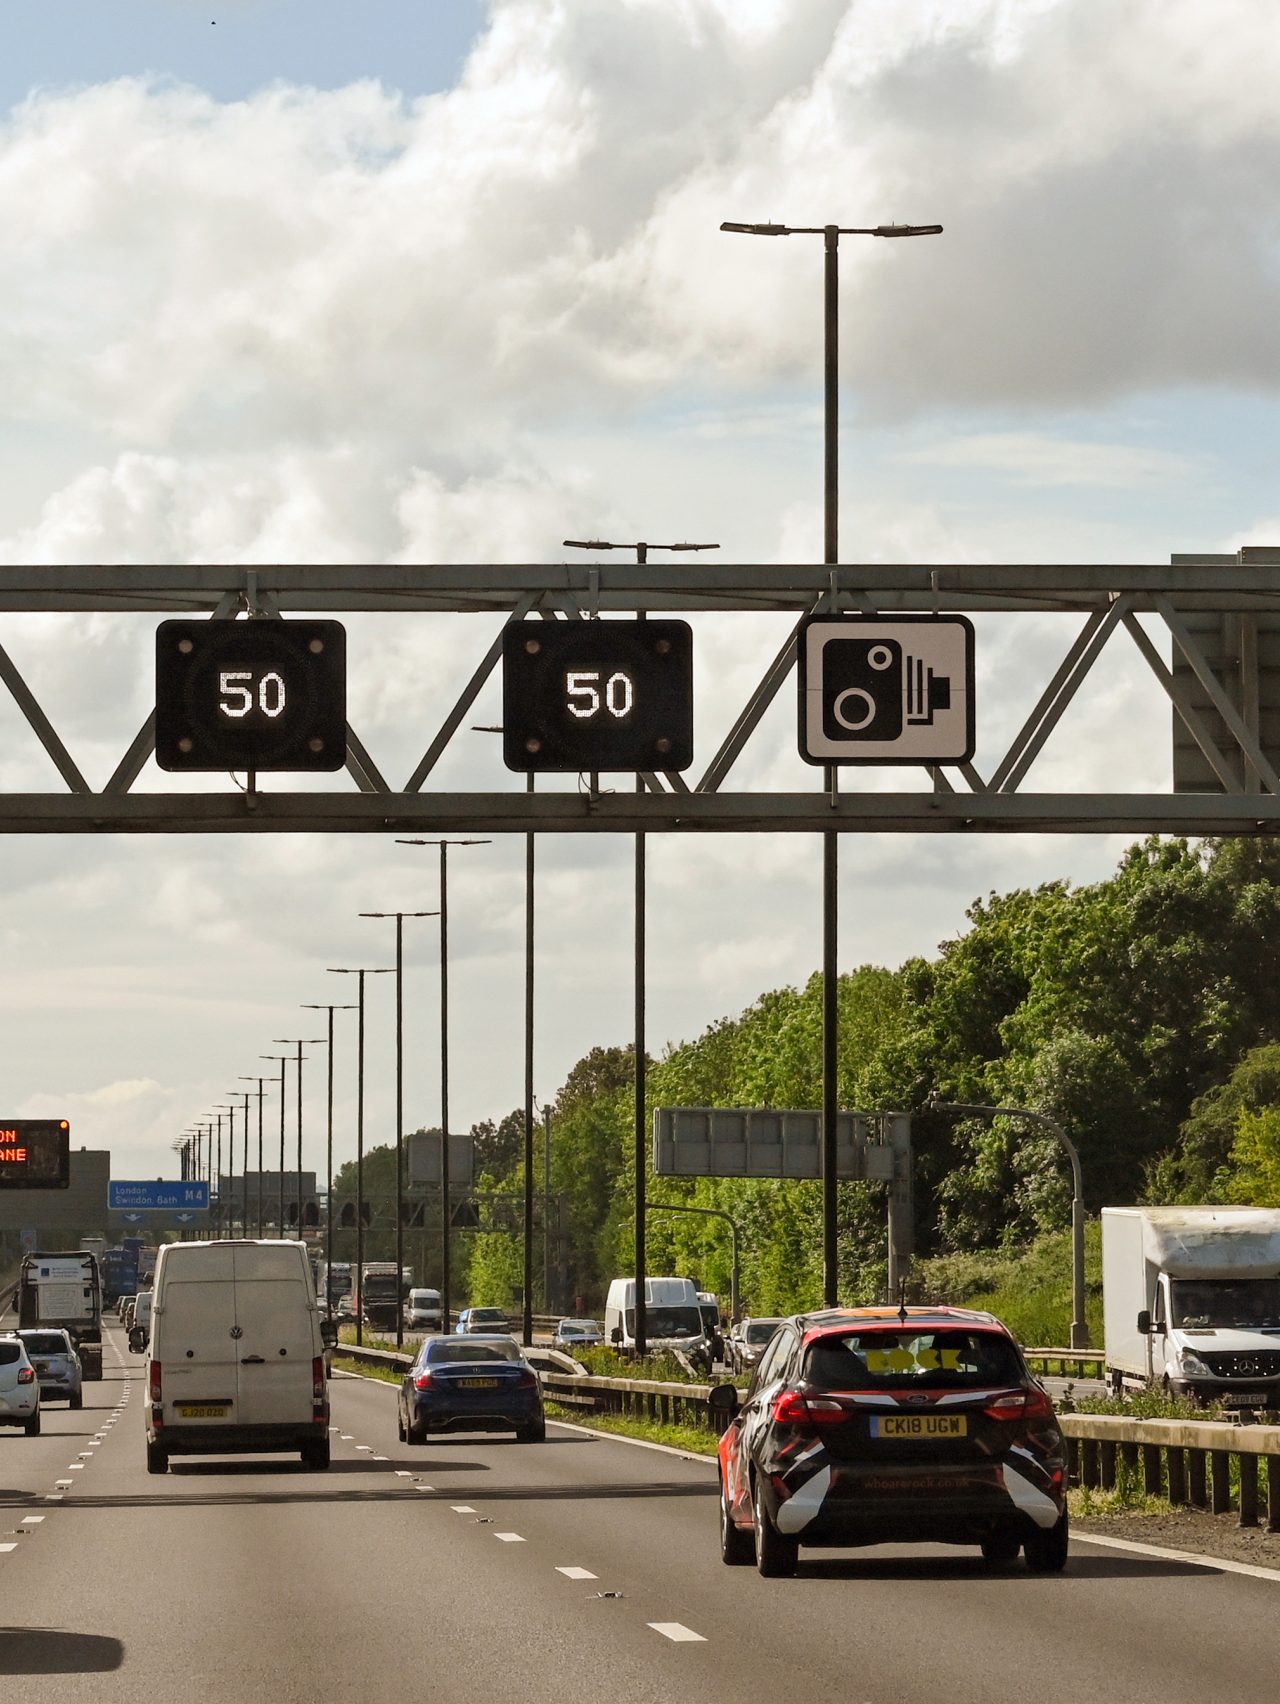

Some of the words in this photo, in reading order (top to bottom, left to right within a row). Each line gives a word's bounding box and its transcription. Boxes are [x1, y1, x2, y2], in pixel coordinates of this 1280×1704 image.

[219, 672, 286, 718] 50
[566, 672, 633, 718] 50
[115, 1186, 147, 1195] London
[884, 1418, 922, 1434] CK18
[926, 1417, 960, 1433] UGW
